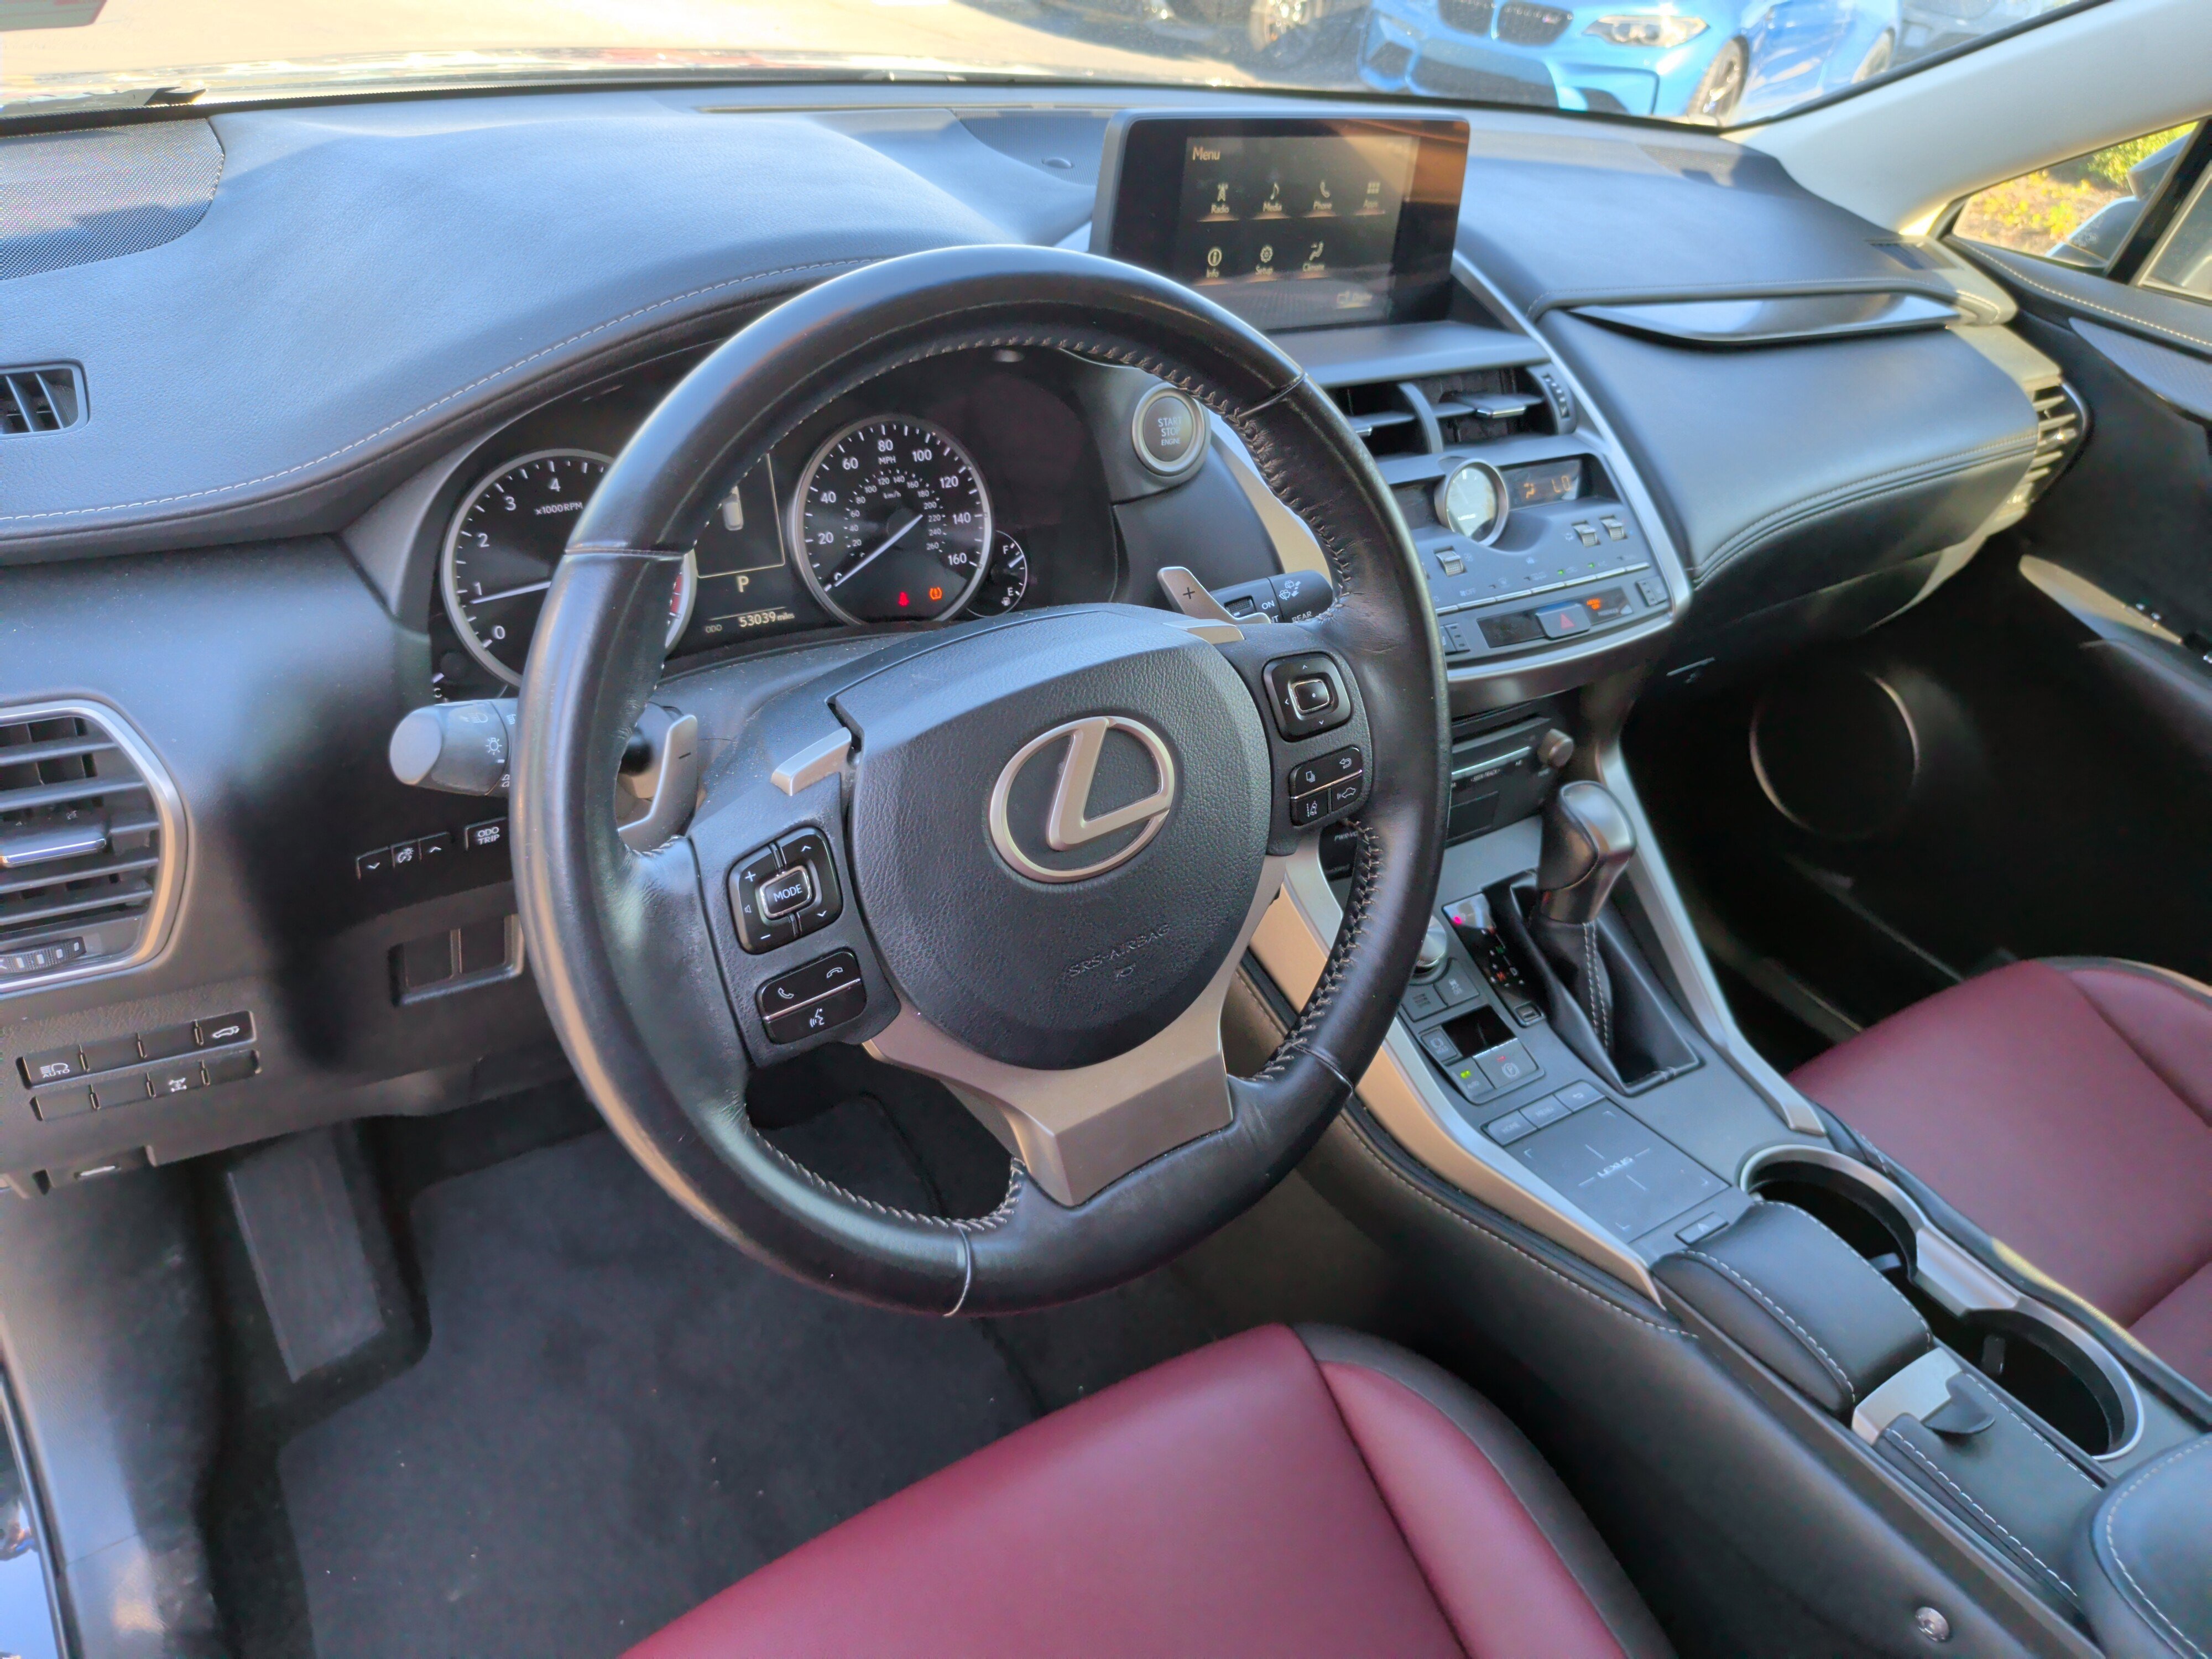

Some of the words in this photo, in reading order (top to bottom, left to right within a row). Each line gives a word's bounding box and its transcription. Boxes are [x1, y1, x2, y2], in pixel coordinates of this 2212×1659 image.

[1192, 147, 1220, 161] Menu
[1211, 203, 1230, 213] Radio
[1262, 201, 1282, 212] Media
[1313, 200, 1332, 210] Phone
[1206, 267, 1219, 278] Info
[1157, 416, 1182, 427] START
[1161, 427, 1181, 437] STOP
[878, 439, 894, 452] 80
[1161, 437, 1181, 446] ENGINE
[878, 456, 896, 465] MPH
[912, 448, 932, 462] 100
[842, 457, 858, 470] 60
[549, 478, 561, 492] 4
[878, 477, 890, 486] 120
[893, 475, 905, 484] 140
[906, 480, 919, 489] 160
[940, 475, 959, 488] 120
[864, 484, 877, 494] 100
[917, 489, 930, 498] 180
[820, 492, 837, 504] 40
[883, 491, 901, 500] km/h
[504, 496, 516, 511] 3
[924, 501, 937, 510] 200
[851, 509, 860, 518] 60
[928, 514, 941, 523] 220
[952, 512, 971, 524] 140
[928, 528, 942, 536] 240
[478, 533, 489, 548] 2
[817, 531, 834, 545] 20
[852, 539, 862, 547] 20
[926, 542, 940, 551] 260
[1003, 545, 1009, 555] F
[948, 553, 967, 566] 160
[474, 582, 482, 596] 1
[737, 575, 749, 593] P
[1008, 587, 1014, 596] E
[1261, 600, 1275, 610] ON
[705, 624, 722, 633] ODO
[738, 612, 776, 628] 53039
[777, 612, 795, 621] miles
[1292, 611, 1312, 623] REAR
[493, 625, 506, 640] 0
[434, 687, 443, 698] C
[477, 827, 499, 837] ODO
[477, 834, 500, 845] TRIP
[773, 884, 802, 902] MODE
[43, 1068, 70, 1078] AUTO
[1597, 1156, 1635, 1179] LEXUS
